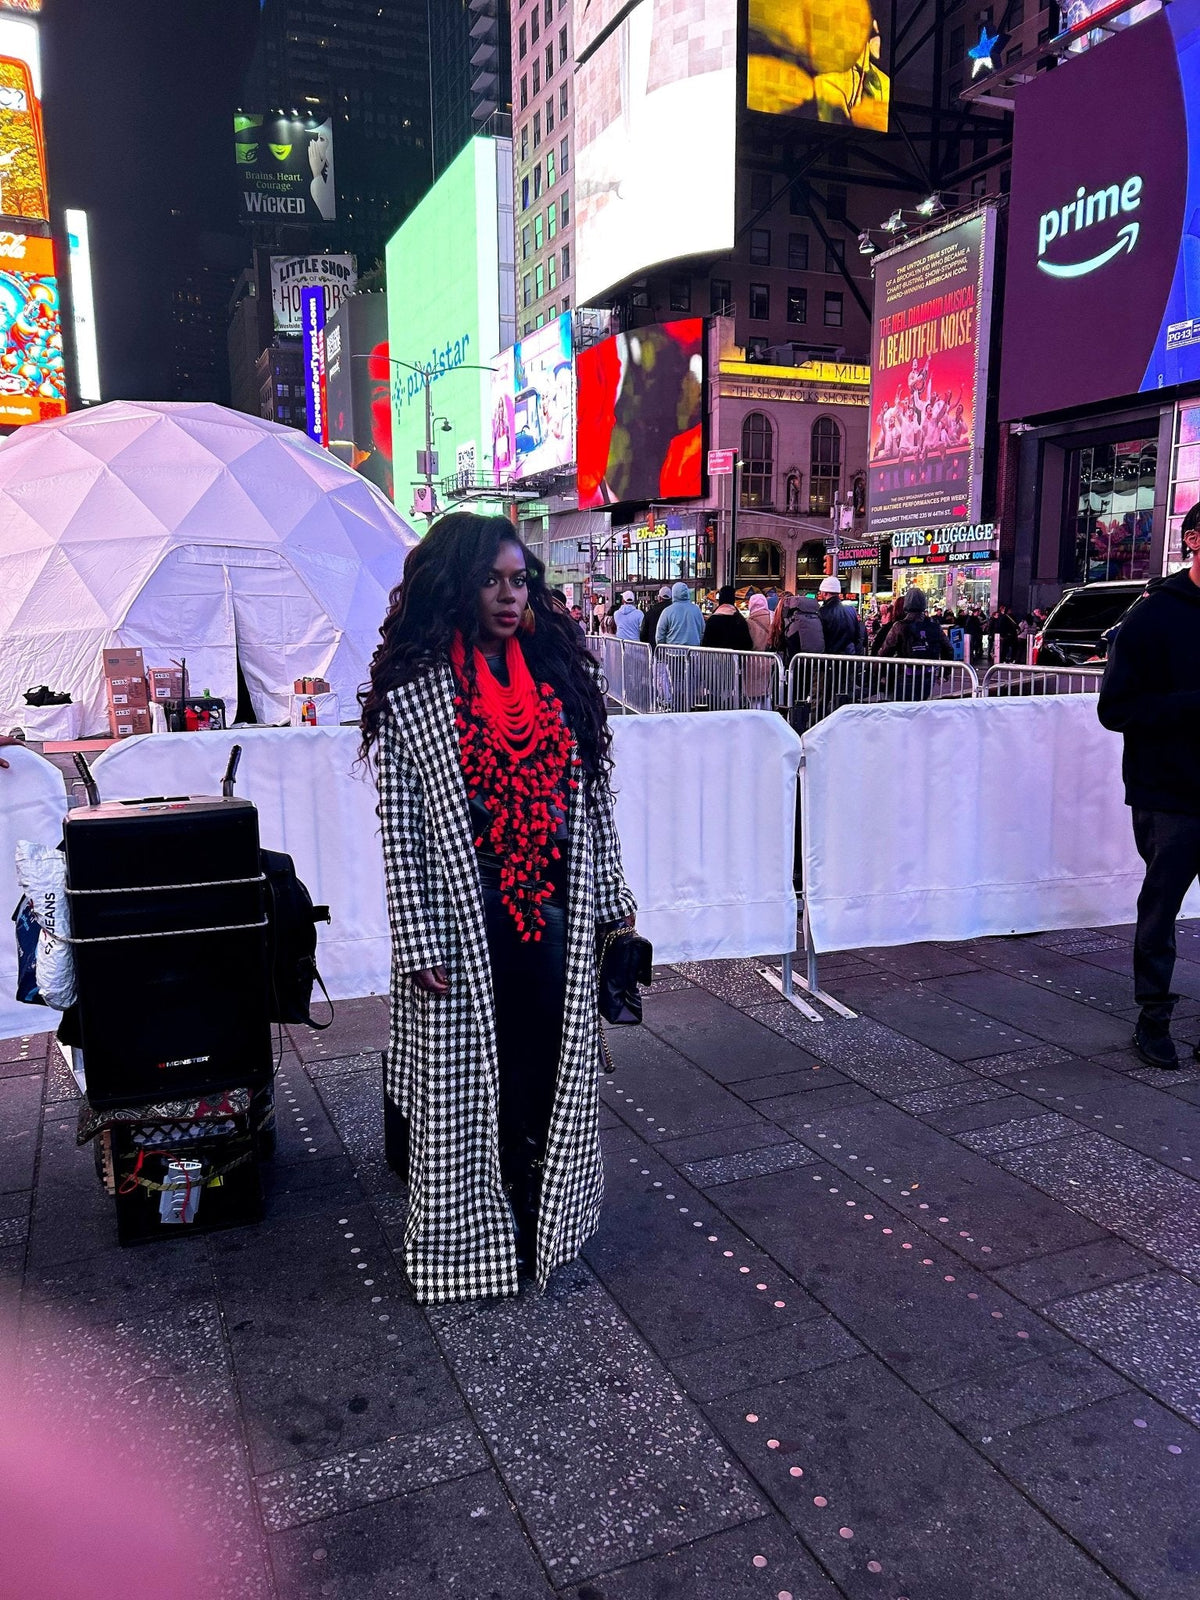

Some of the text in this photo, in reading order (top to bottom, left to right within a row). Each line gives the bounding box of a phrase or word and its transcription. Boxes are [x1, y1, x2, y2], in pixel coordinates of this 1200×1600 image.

[245, 171, 303, 182] Brains. Heart.
[256, 181, 293, 192] Courage.
[1038, 175, 1143, 256] prime
[897, 243, 959, 275] THE UNTOLD TRUE STORY
[280, 258, 351, 282] LITTLE SHOP
[886, 279, 893, 288] OF
[897, 267, 921, 284] BROOKLYN
[922, 263, 931, 274] KID
[931, 258, 944, 271] WHO
[944, 249, 965, 264] BECAME
[925, 271, 953, 287] AMERICAN
[281, 284, 352, 322] HOORS
[880, 284, 976, 338] THE NEIL DIAMOND MUSICAL
[878, 306, 974, 370] A BEAUTIFUL NOISE
[1168, 329, 1191, 342] PG-13
[407, 333, 470, 406] pixelstar
[835, 365, 870, 381] MILL
[735, 385, 870, 405] THE SHOW FOLKS SHOE SHO
[871, 505, 883, 513] FOUR
[902, 497, 940, 508] PERFORMANCES
[940, 495, 951, 503] PER
[900, 513, 919, 521] THEATRE
[637, 523, 667, 540] EXPESS
[892, 523, 994, 548] GIFTS LUGGAGE
[839, 547, 879, 560] ELECTRONICS
[949, 552, 971, 561] SONY
[839, 560, 857, 568] CAMERA
[166, 1055, 210, 1068] MONSTER
